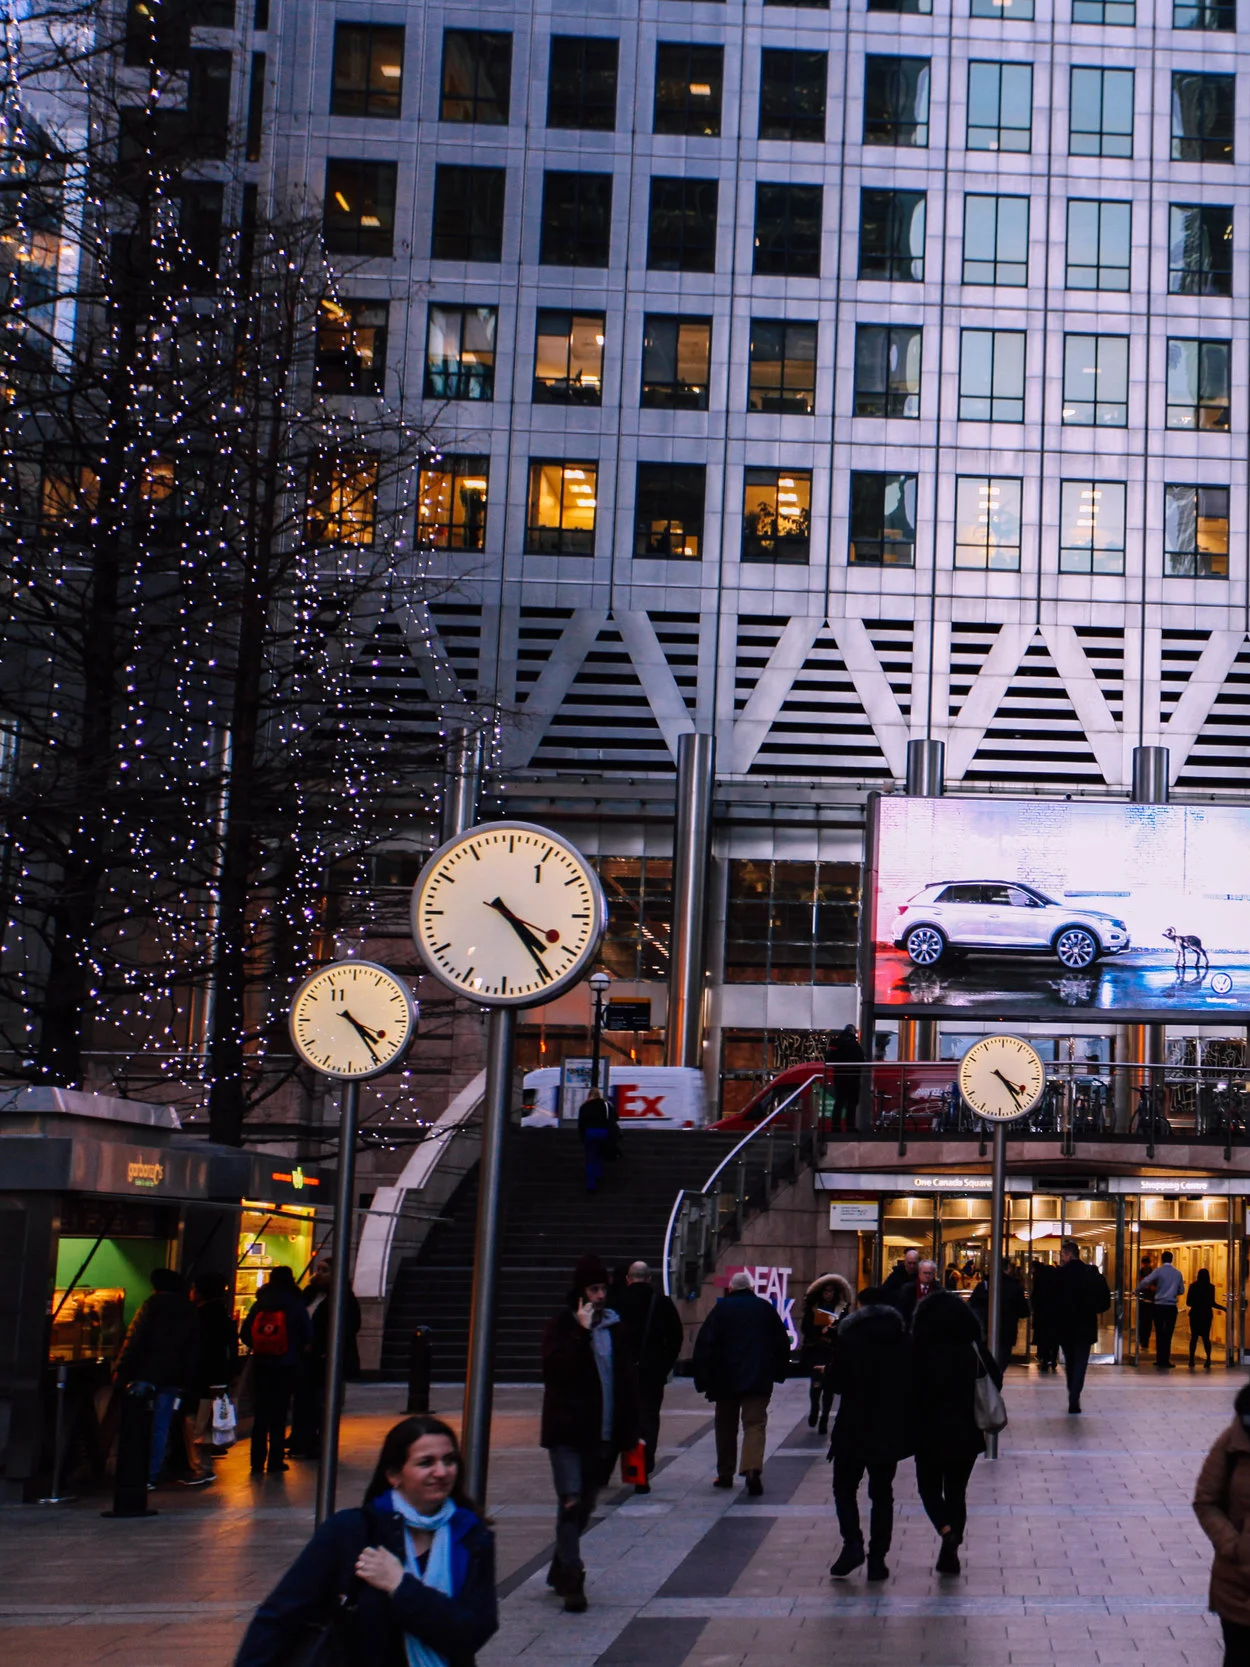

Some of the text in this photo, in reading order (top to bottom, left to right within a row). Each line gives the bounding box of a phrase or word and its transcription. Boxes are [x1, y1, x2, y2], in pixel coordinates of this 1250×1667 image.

[533, 864, 542, 884] 1
[331, 989, 345, 1002] 11
[914, 1178, 993, 1189] One Canada Square
[1140, 1180, 1208, 1192] Shopping Centre
